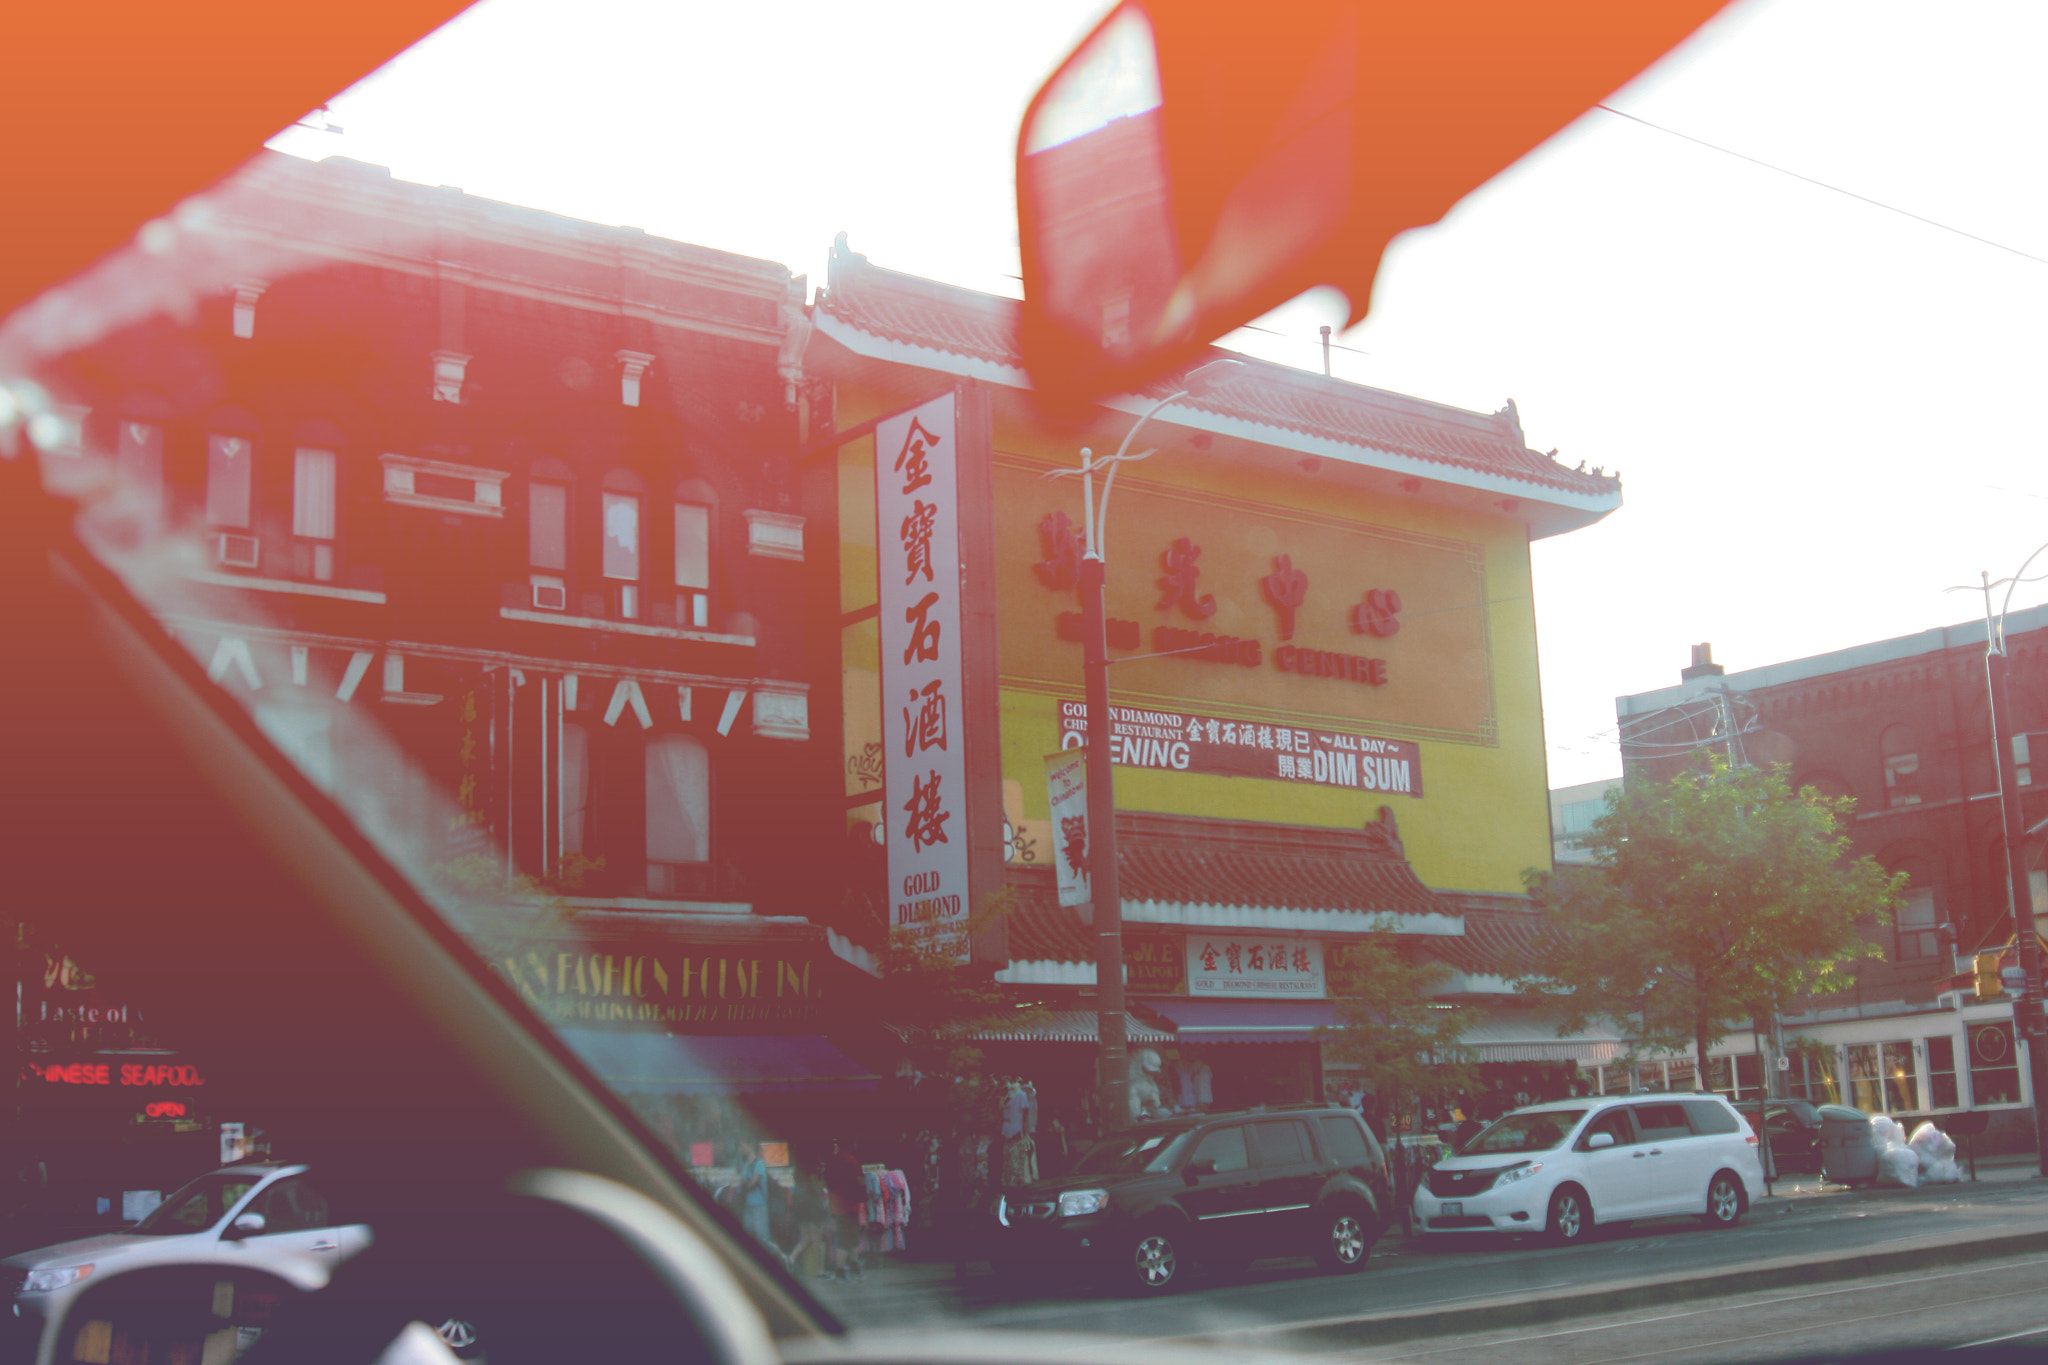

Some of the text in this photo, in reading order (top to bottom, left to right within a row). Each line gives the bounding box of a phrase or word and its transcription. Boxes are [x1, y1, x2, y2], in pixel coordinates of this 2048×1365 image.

[893, 416, 951, 854] 金寶石酒樓
[1276, 645, 1388, 686] CENTRE
[1063, 702, 1183, 728] GOLN DIAMOND
[1114, 722, 1183, 741] RESTAURANT
[1062, 730, 1190, 770] OENING
[1313, 749, 1411, 793] DIM SUM
[903, 870, 940, 897] GOLD
[557, 953, 668, 998] FASHION
[682, 957, 763, 999] HOUSE
[1200, 941, 1312, 974] 金寶石酒樓
